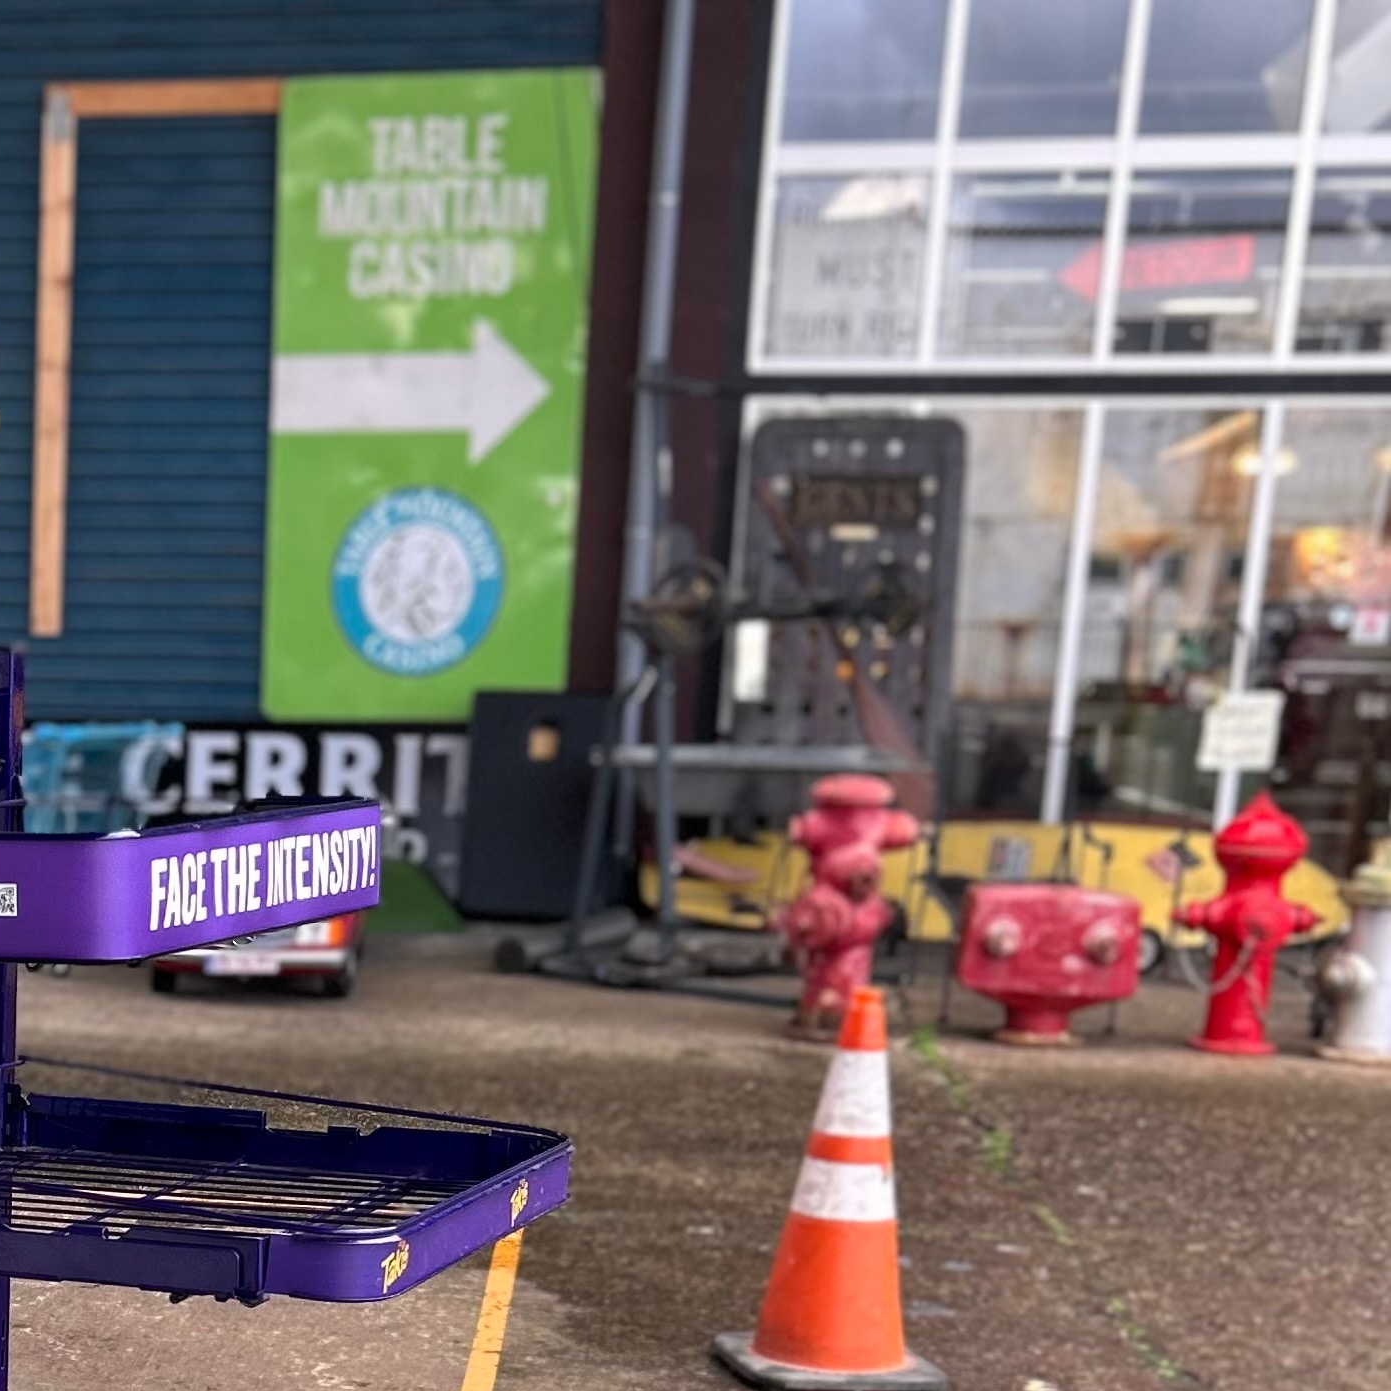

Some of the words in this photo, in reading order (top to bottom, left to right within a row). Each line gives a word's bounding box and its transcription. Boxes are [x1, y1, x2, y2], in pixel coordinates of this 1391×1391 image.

[368, 113, 508, 171] TABLE
[317, 174, 549, 240] MOUNTAIN
[348, 239, 515, 299] CASINO
[149, 851, 208, 931] FACE
[211, 843, 262, 917] THE
[266, 825, 376, 907] INTENSITY!
